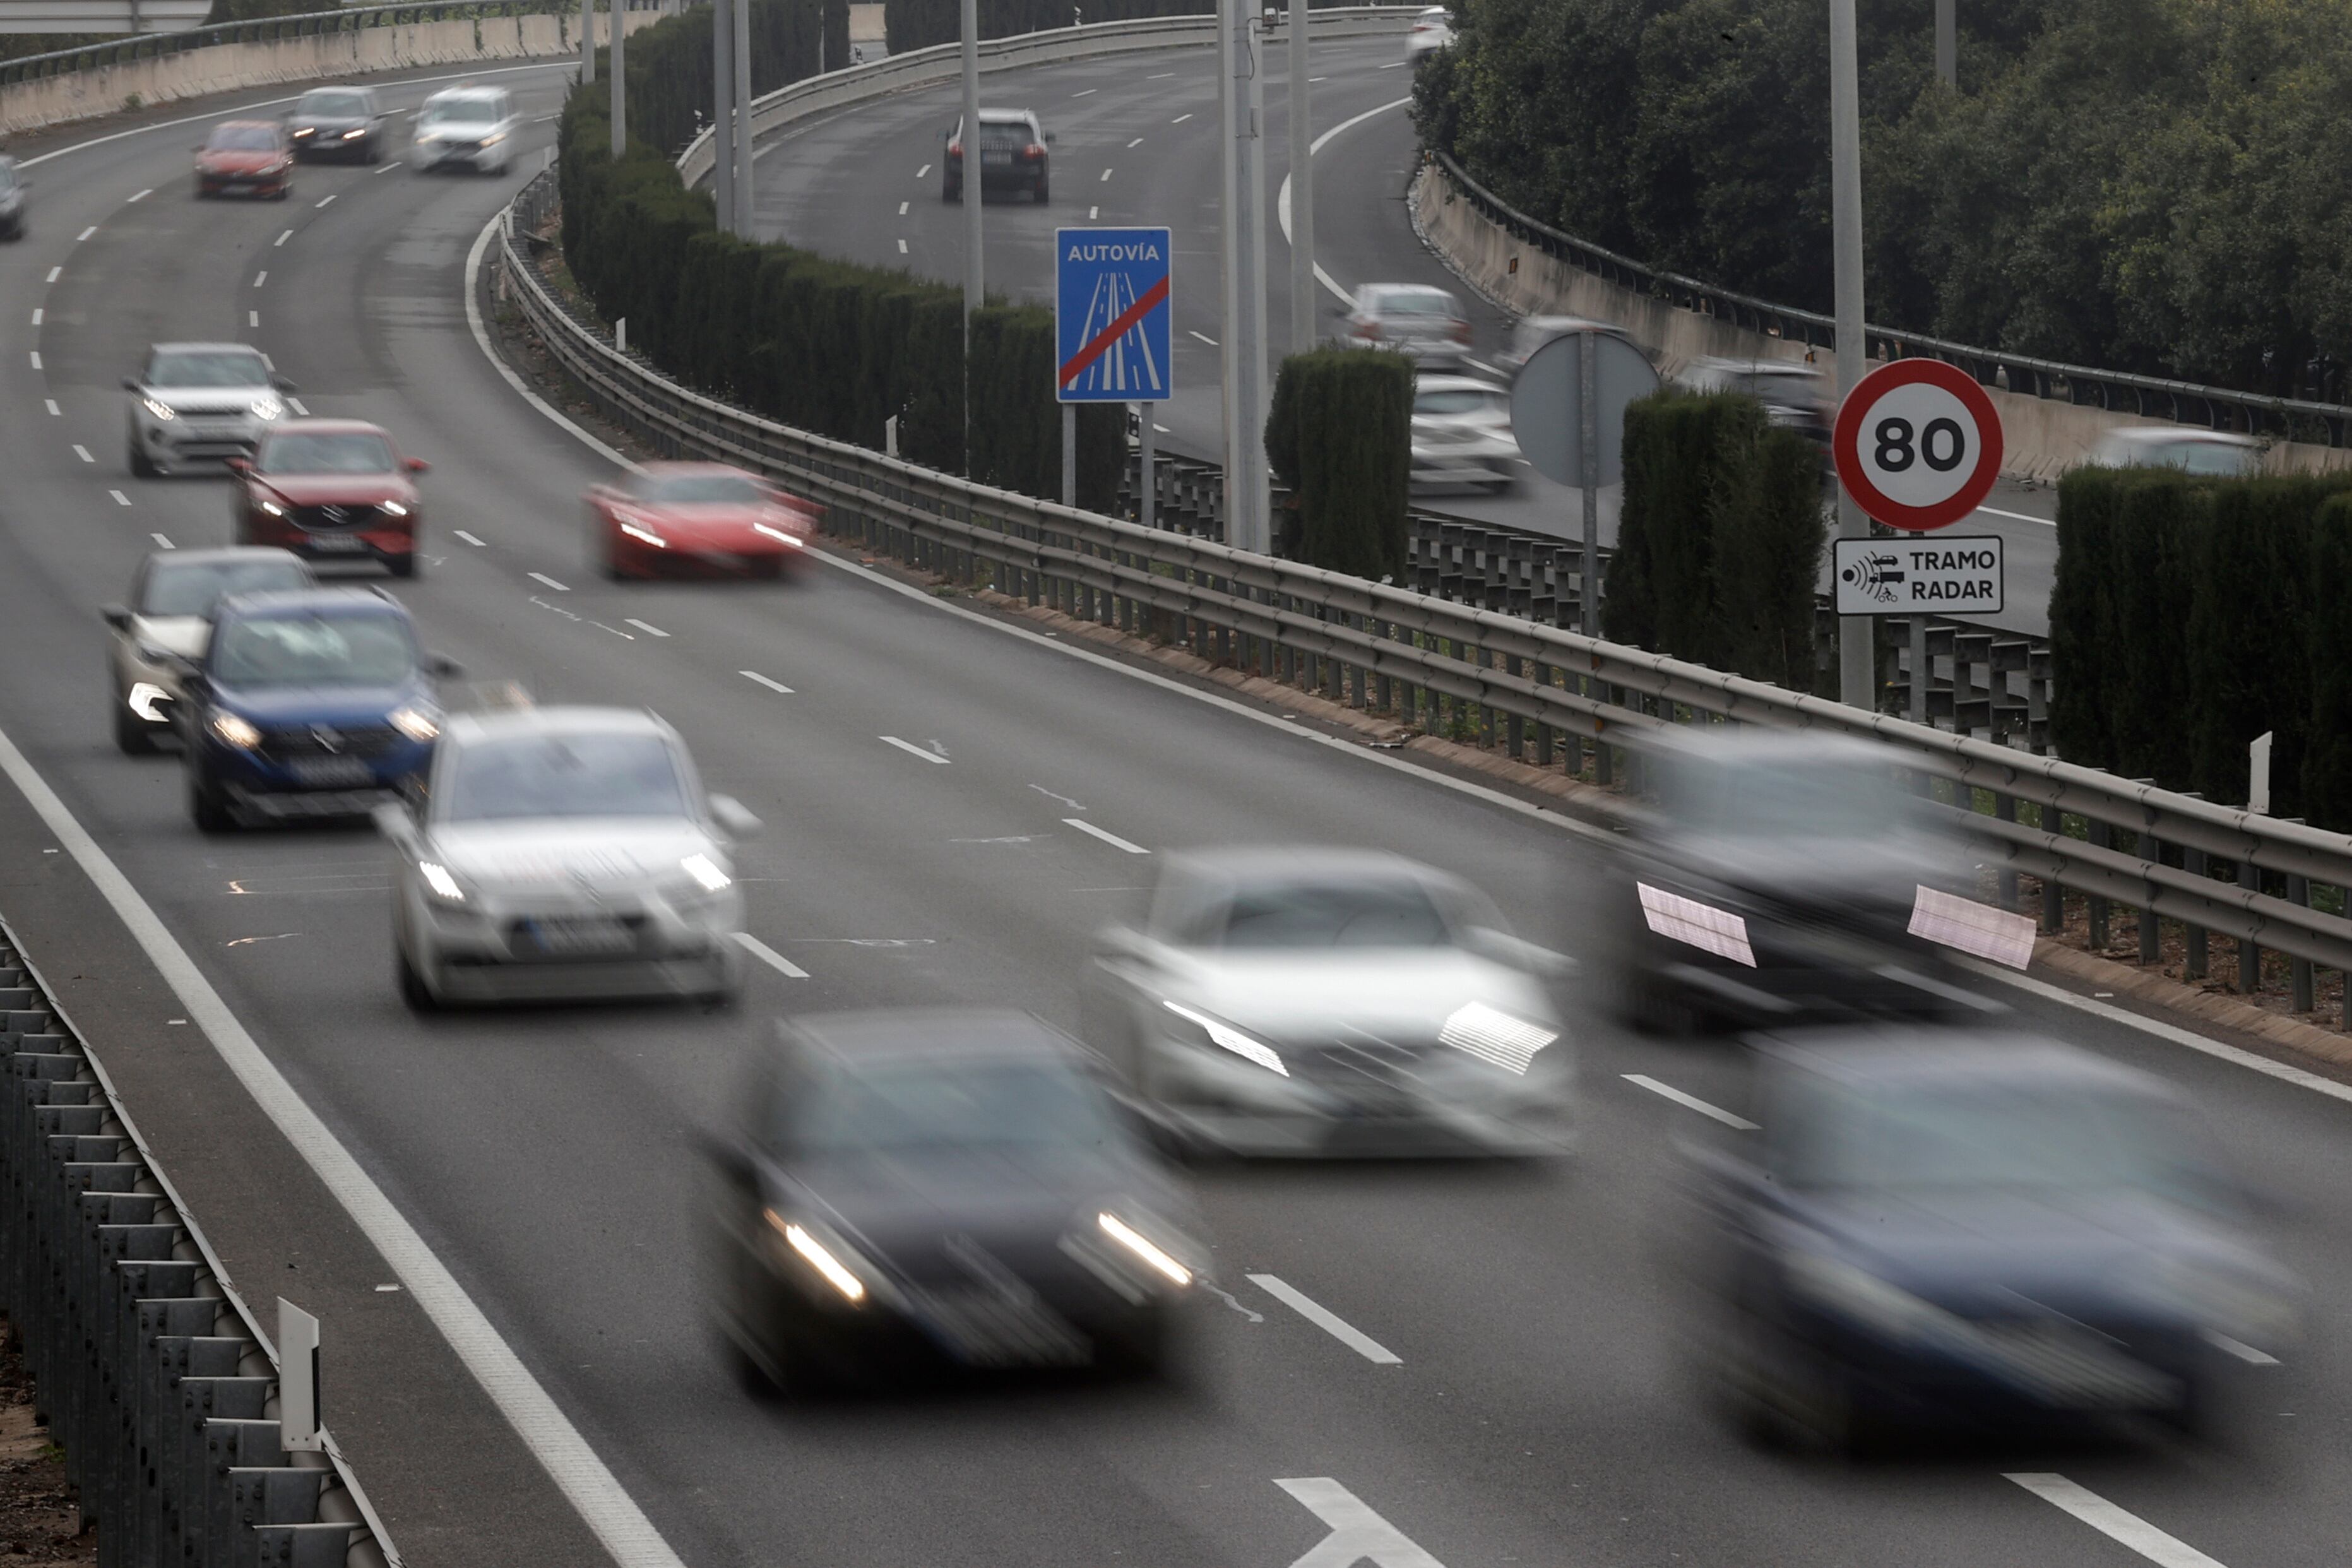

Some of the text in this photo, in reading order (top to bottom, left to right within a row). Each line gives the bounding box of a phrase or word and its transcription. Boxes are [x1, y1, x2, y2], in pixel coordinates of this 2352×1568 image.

[1068, 242, 1159, 261] AUTOVÍA
[1874, 417, 1965, 472] 80
[1910, 550, 1995, 570] TRAMO
[1911, 580, 1993, 600] RADAR
